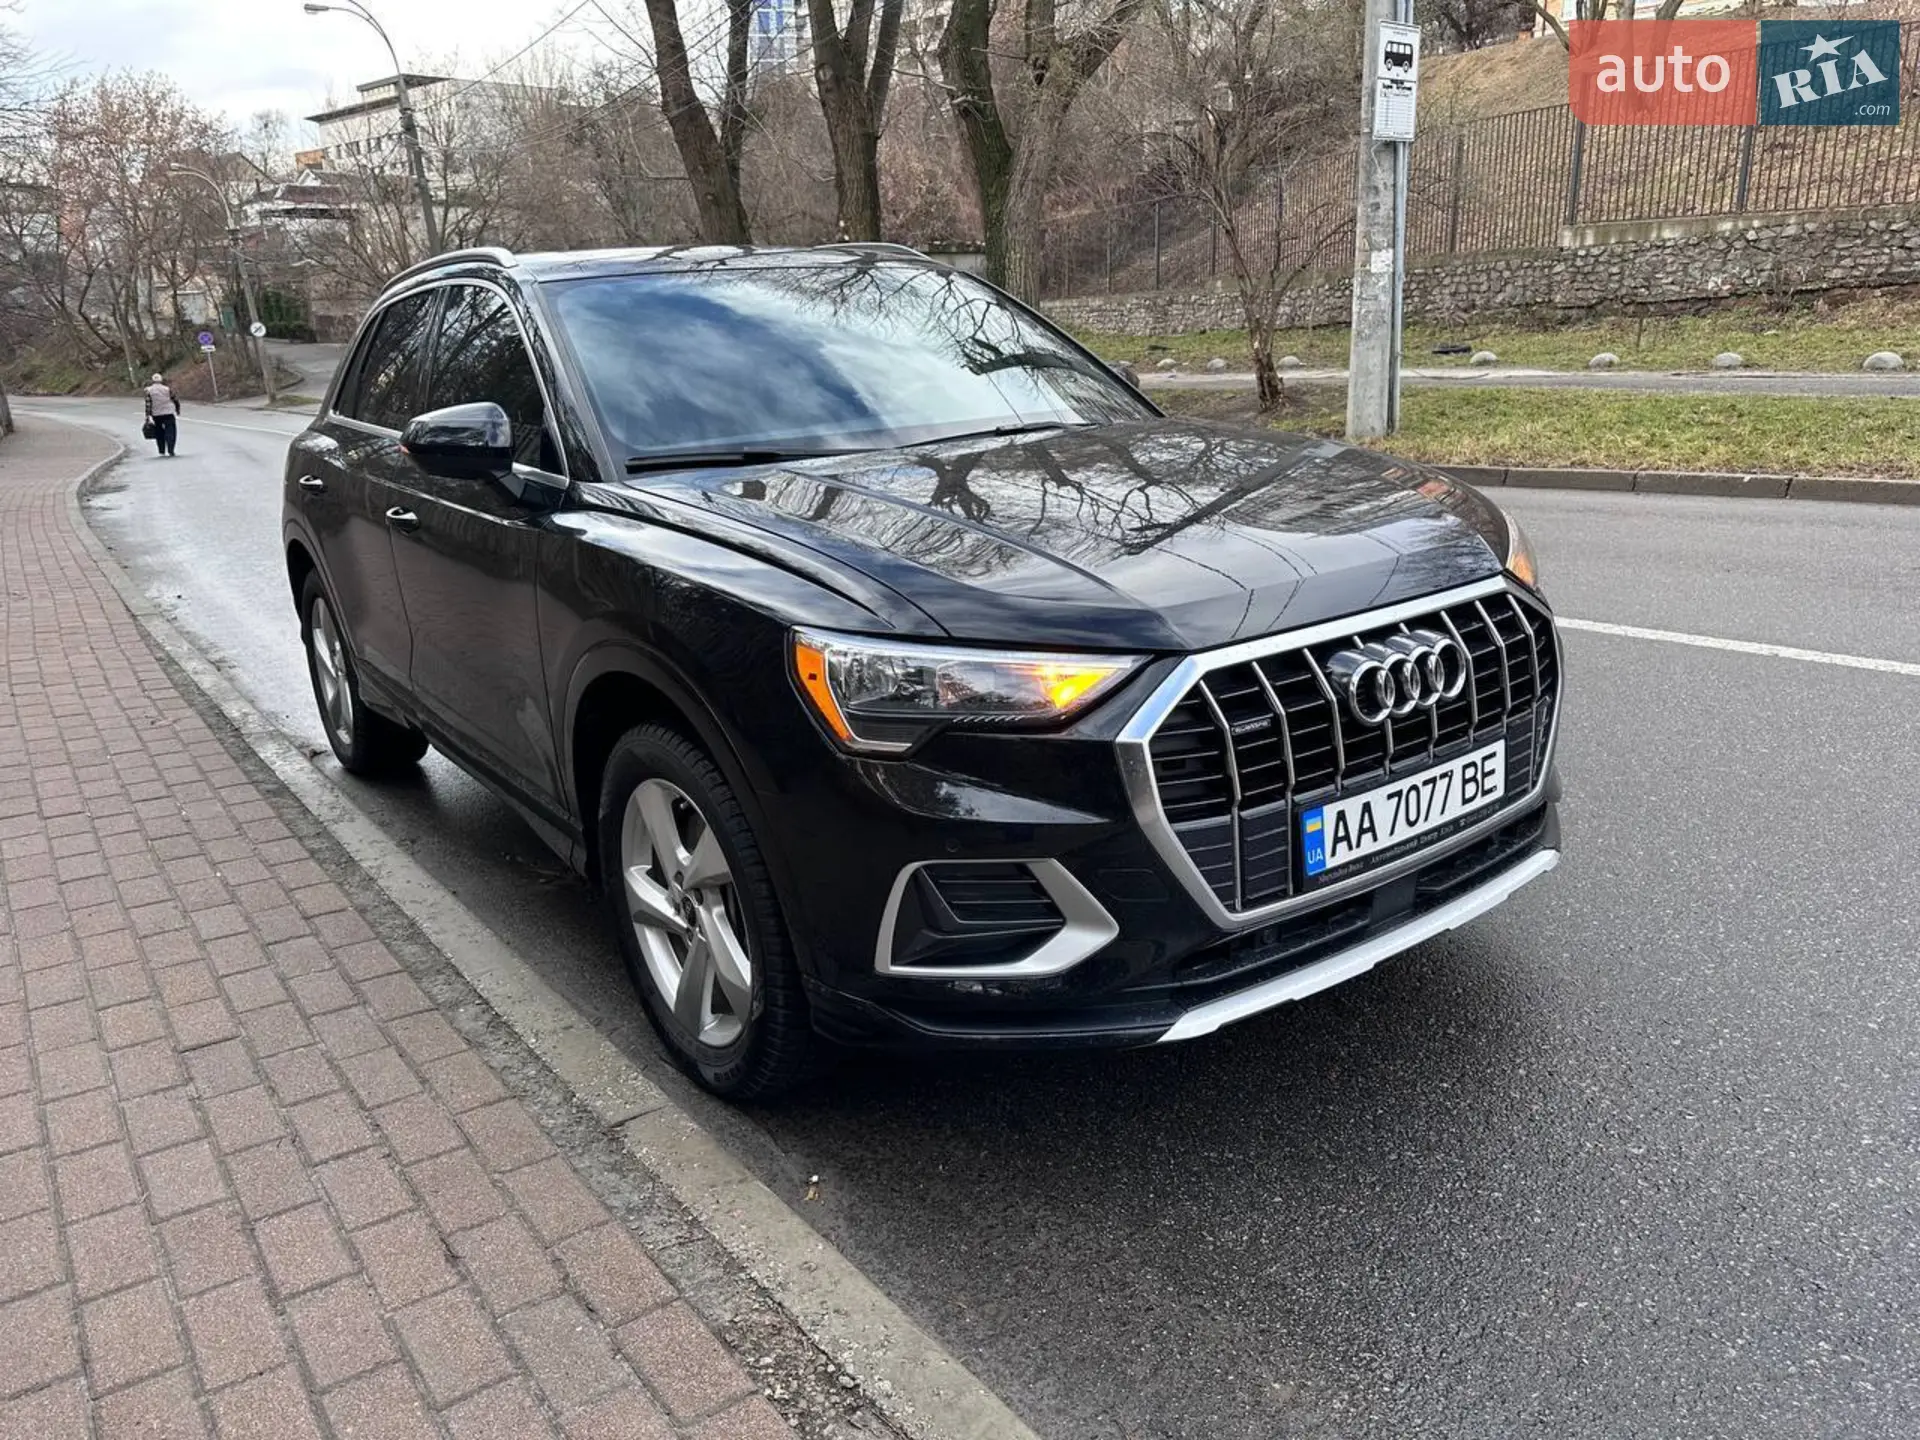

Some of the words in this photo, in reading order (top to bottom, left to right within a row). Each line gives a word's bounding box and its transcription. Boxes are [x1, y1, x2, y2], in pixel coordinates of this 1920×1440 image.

[1330, 800, 1378, 858] AA
[1386, 769, 1454, 837] 7077
[1461, 751, 1497, 806] BE
[1307, 847, 1324, 864] UA
